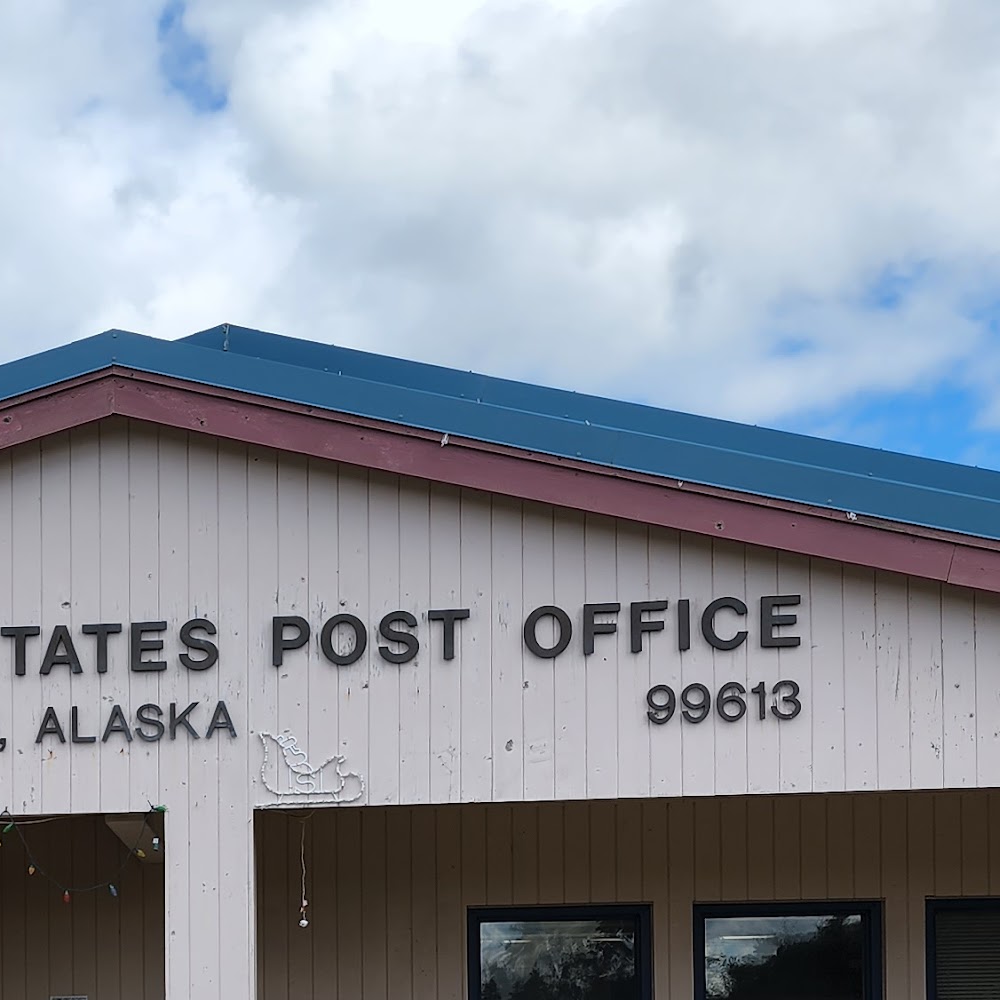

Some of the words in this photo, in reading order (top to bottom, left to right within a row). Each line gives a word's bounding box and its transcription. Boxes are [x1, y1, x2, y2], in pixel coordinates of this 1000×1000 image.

[271, 608, 470, 667] POST
[523, 594, 801, 659] OFFICE
[35, 700, 237, 744] ALASKA
[646, 679, 802, 725] 99613
